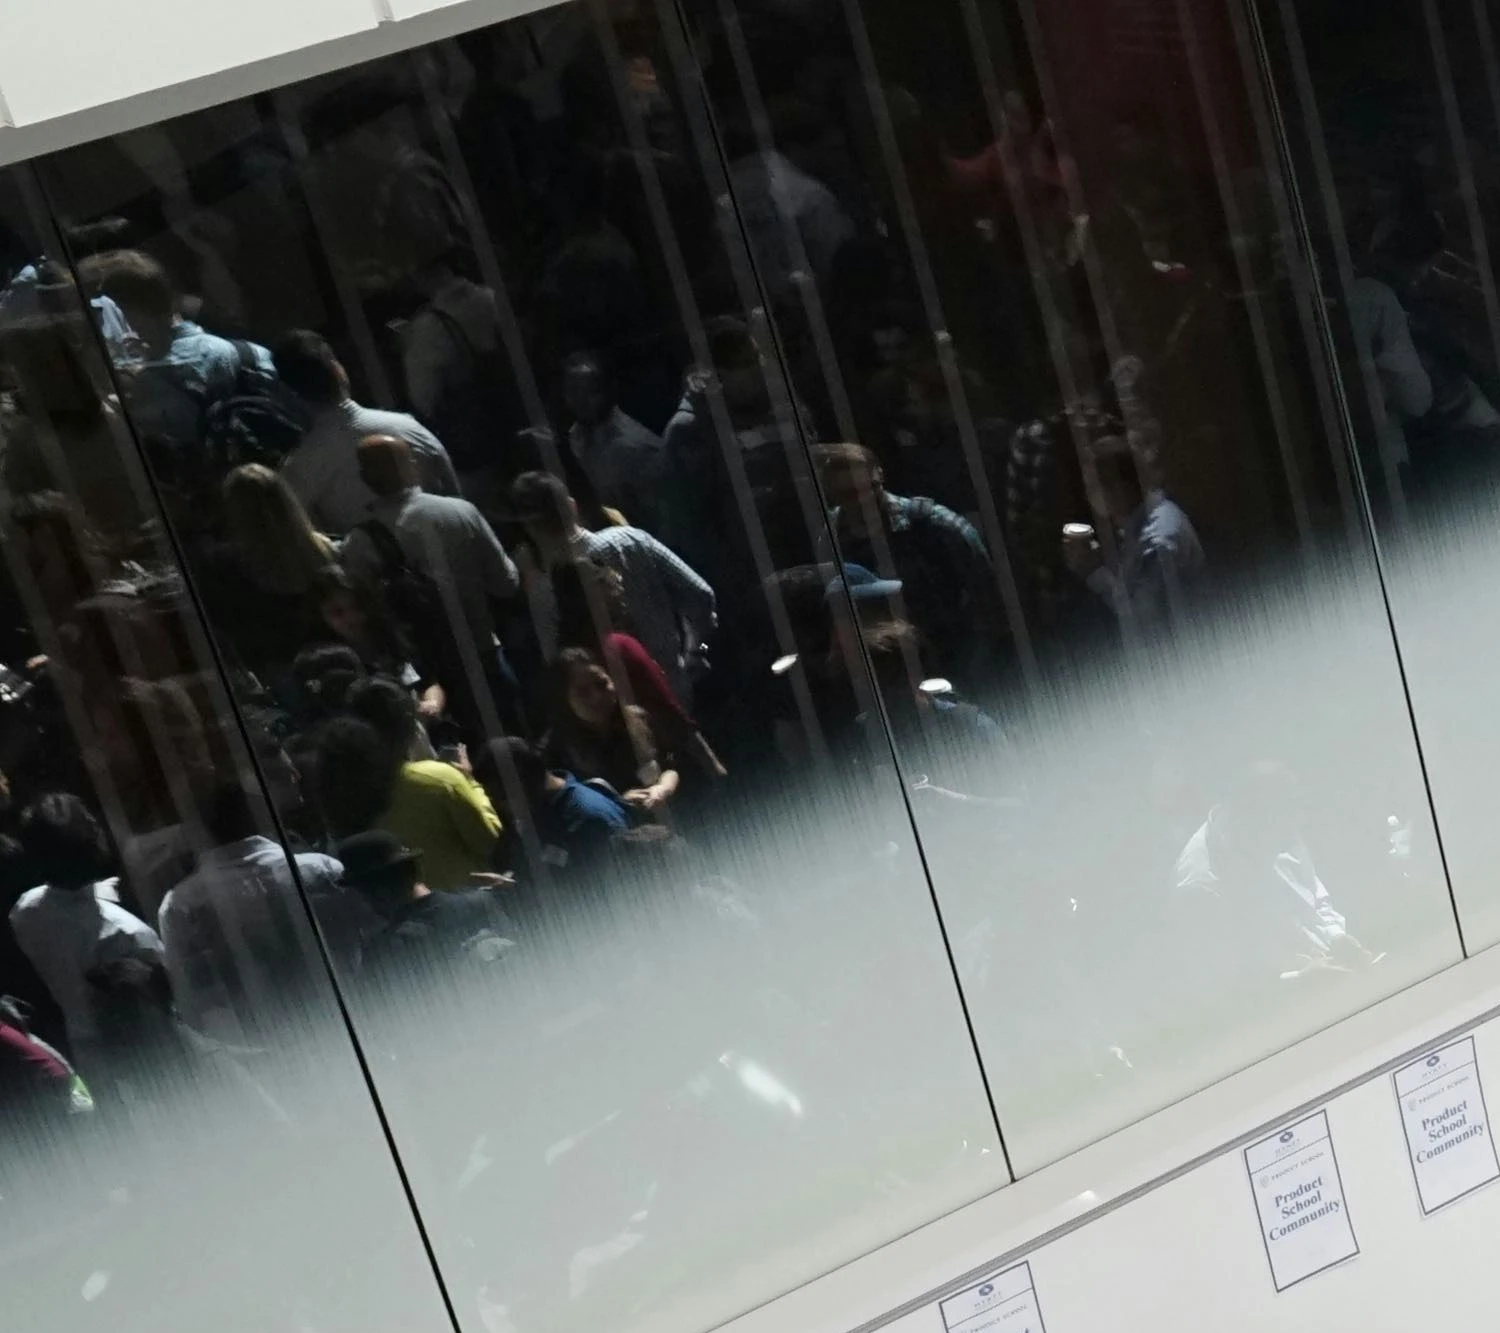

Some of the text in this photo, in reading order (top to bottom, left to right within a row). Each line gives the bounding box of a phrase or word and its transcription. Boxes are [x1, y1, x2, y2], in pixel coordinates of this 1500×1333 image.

[1421, 1100, 1469, 1131] Product
[1428, 1114, 1468, 1143] School
[1416, 1122, 1484, 1164] Community
[1274, 1175, 1324, 1208] Product
[1281, 1191, 1322, 1220] School
[1269, 1199, 1341, 1241] Community
